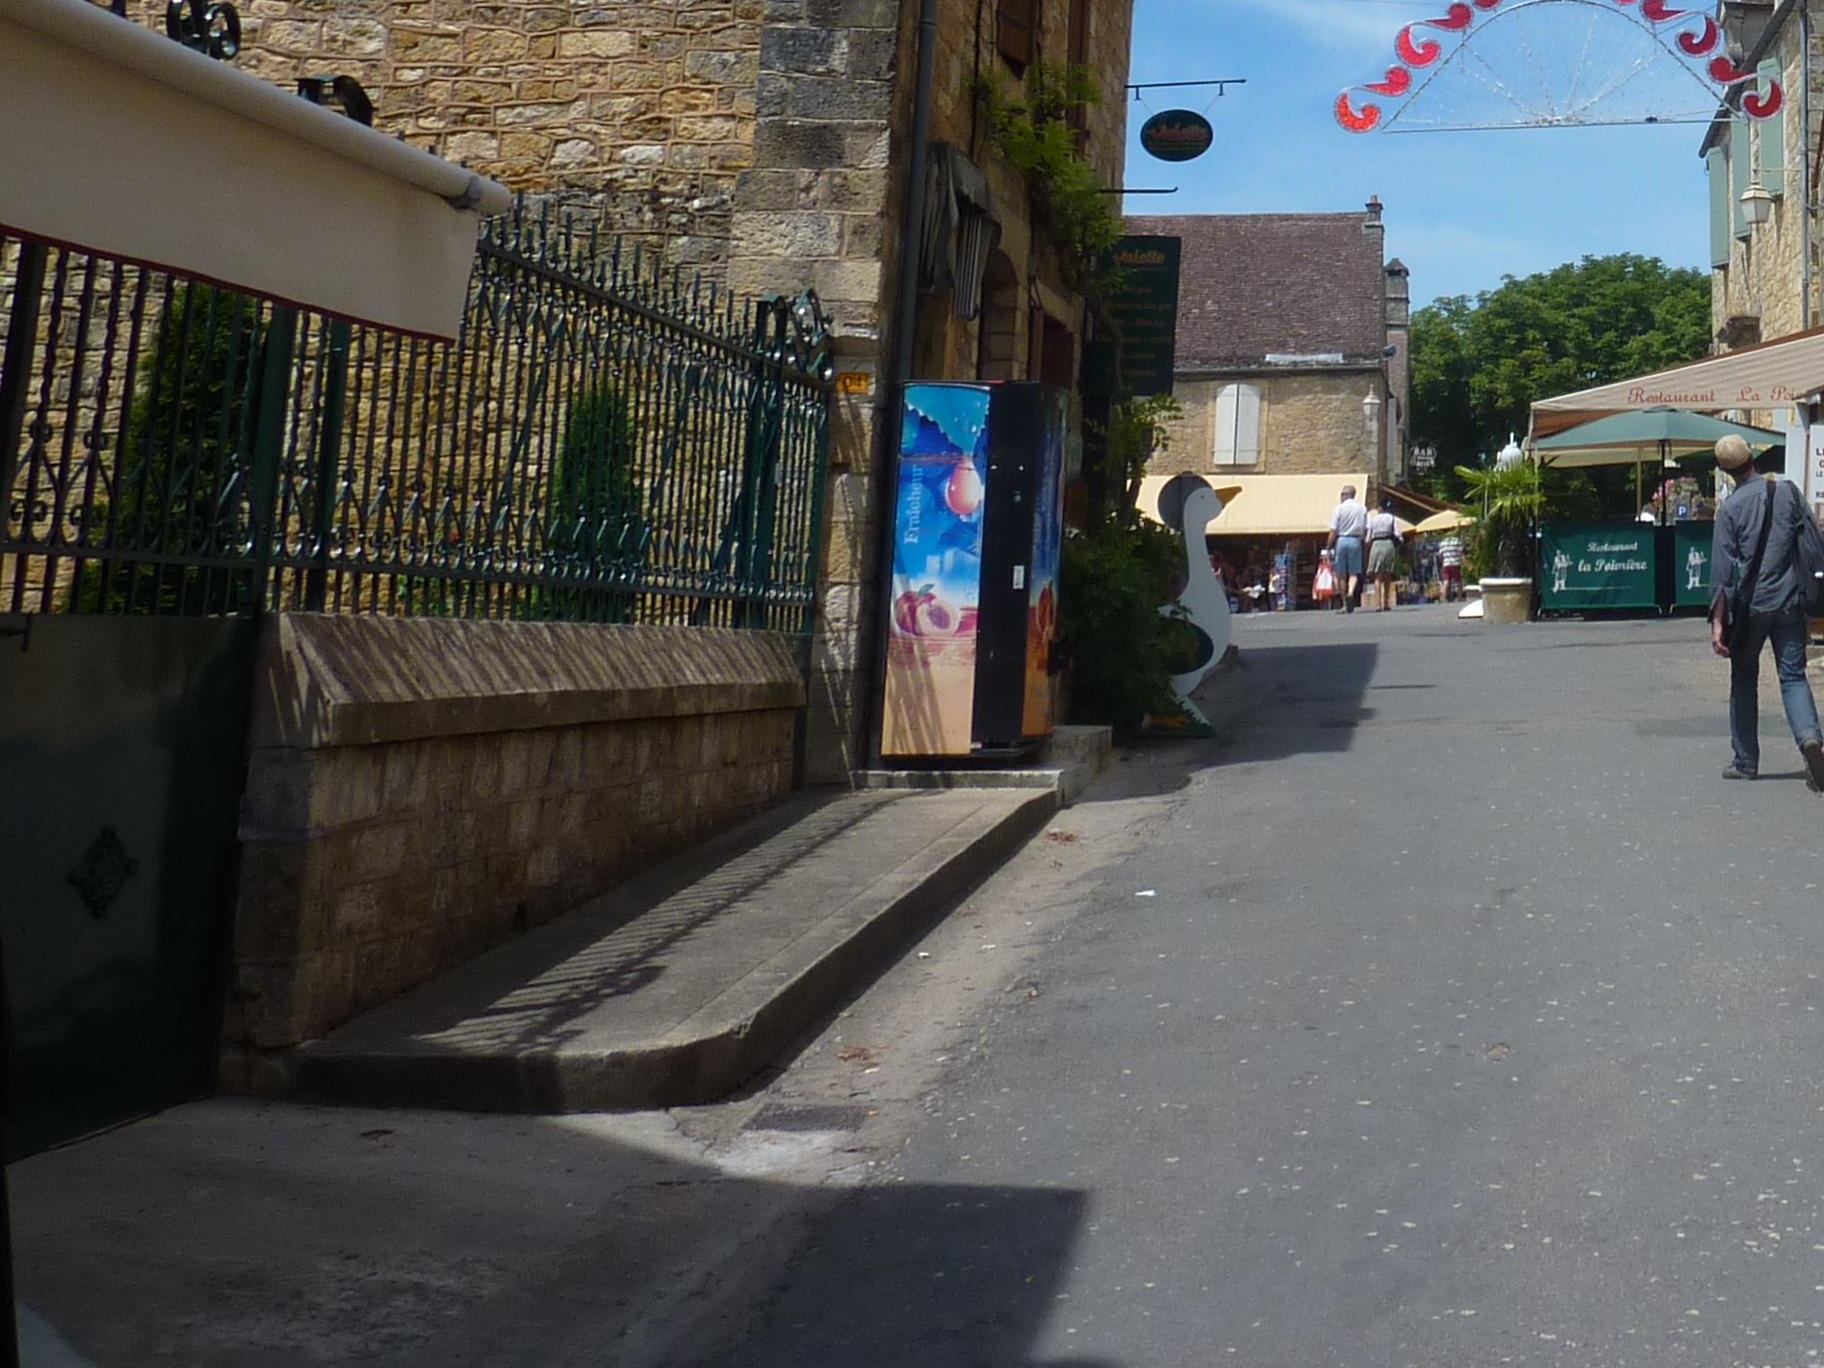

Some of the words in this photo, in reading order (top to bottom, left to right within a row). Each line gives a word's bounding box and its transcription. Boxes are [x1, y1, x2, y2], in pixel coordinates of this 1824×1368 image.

[1628, 387, 1716, 404] Restaurant
[1736, 385, 1760, 402] La
[1587, 541, 1639, 553] Restaurant
